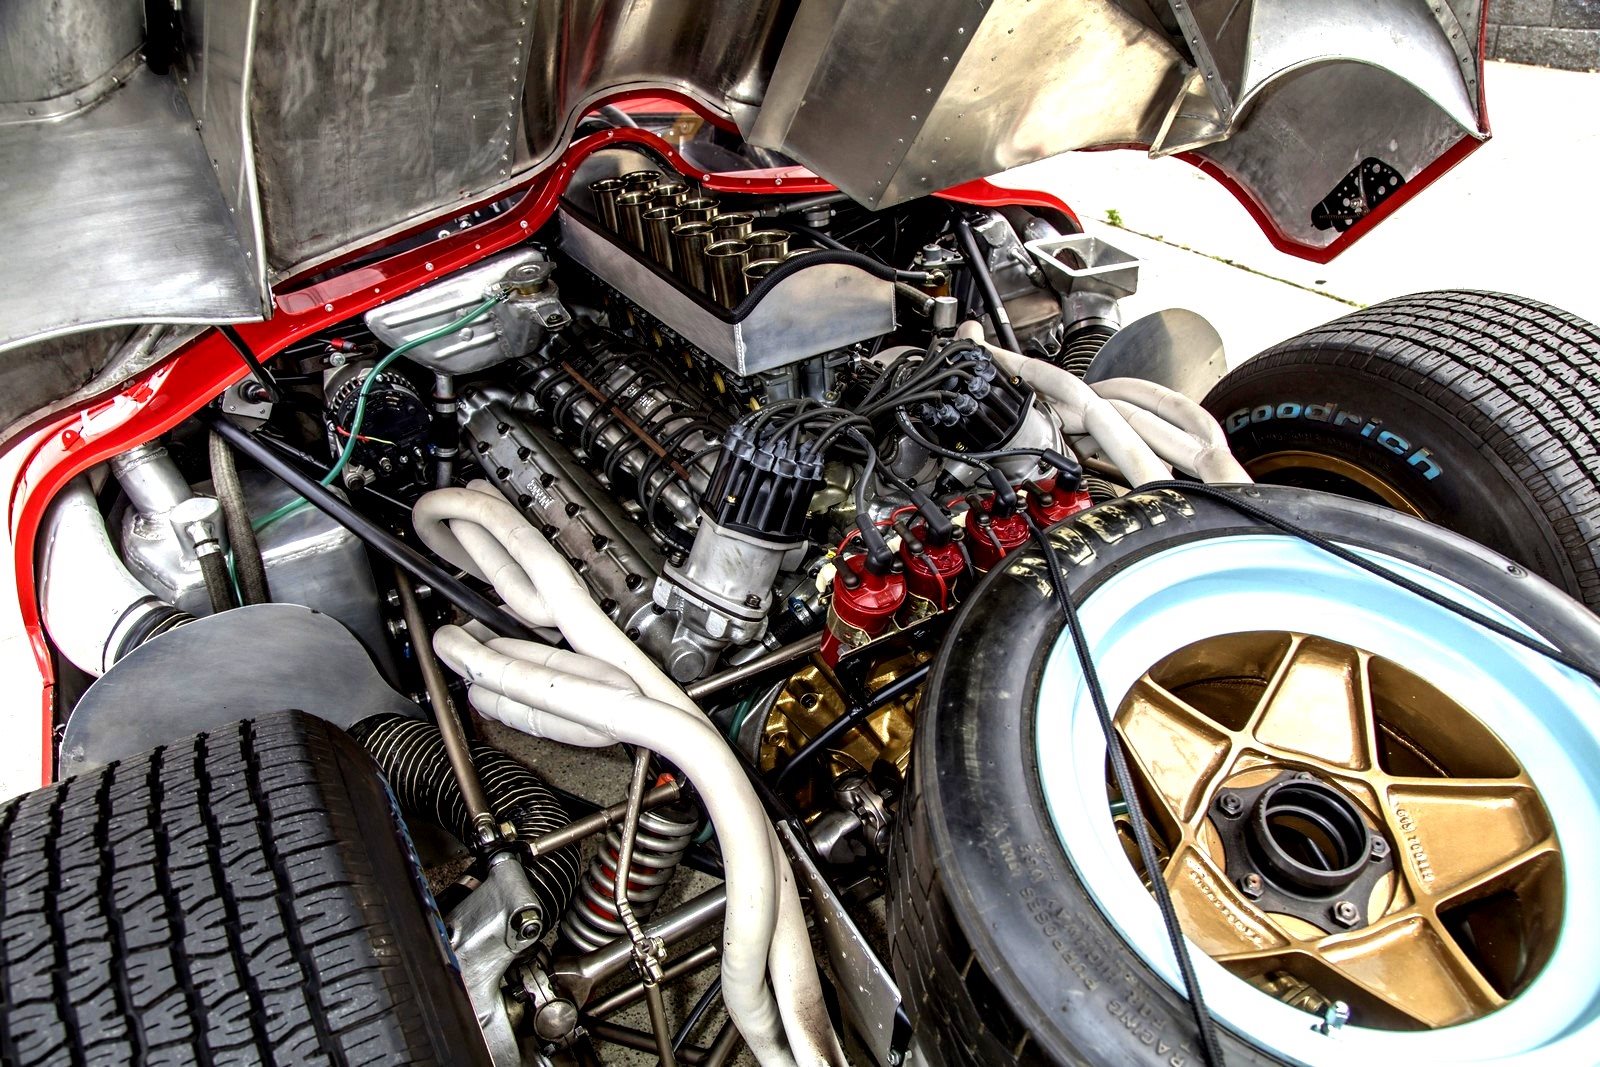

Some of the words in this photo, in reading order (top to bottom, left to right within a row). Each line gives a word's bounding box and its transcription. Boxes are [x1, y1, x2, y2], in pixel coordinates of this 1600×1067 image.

[1226, 402, 1442, 481] Goodrich
[1019, 887, 1099, 992] PURPOSES
[1045, 897, 1117, 985] HIGHWAY
[1105, 998, 1185, 1067] RACING
[1123, 988, 1168, 1031] FOR
